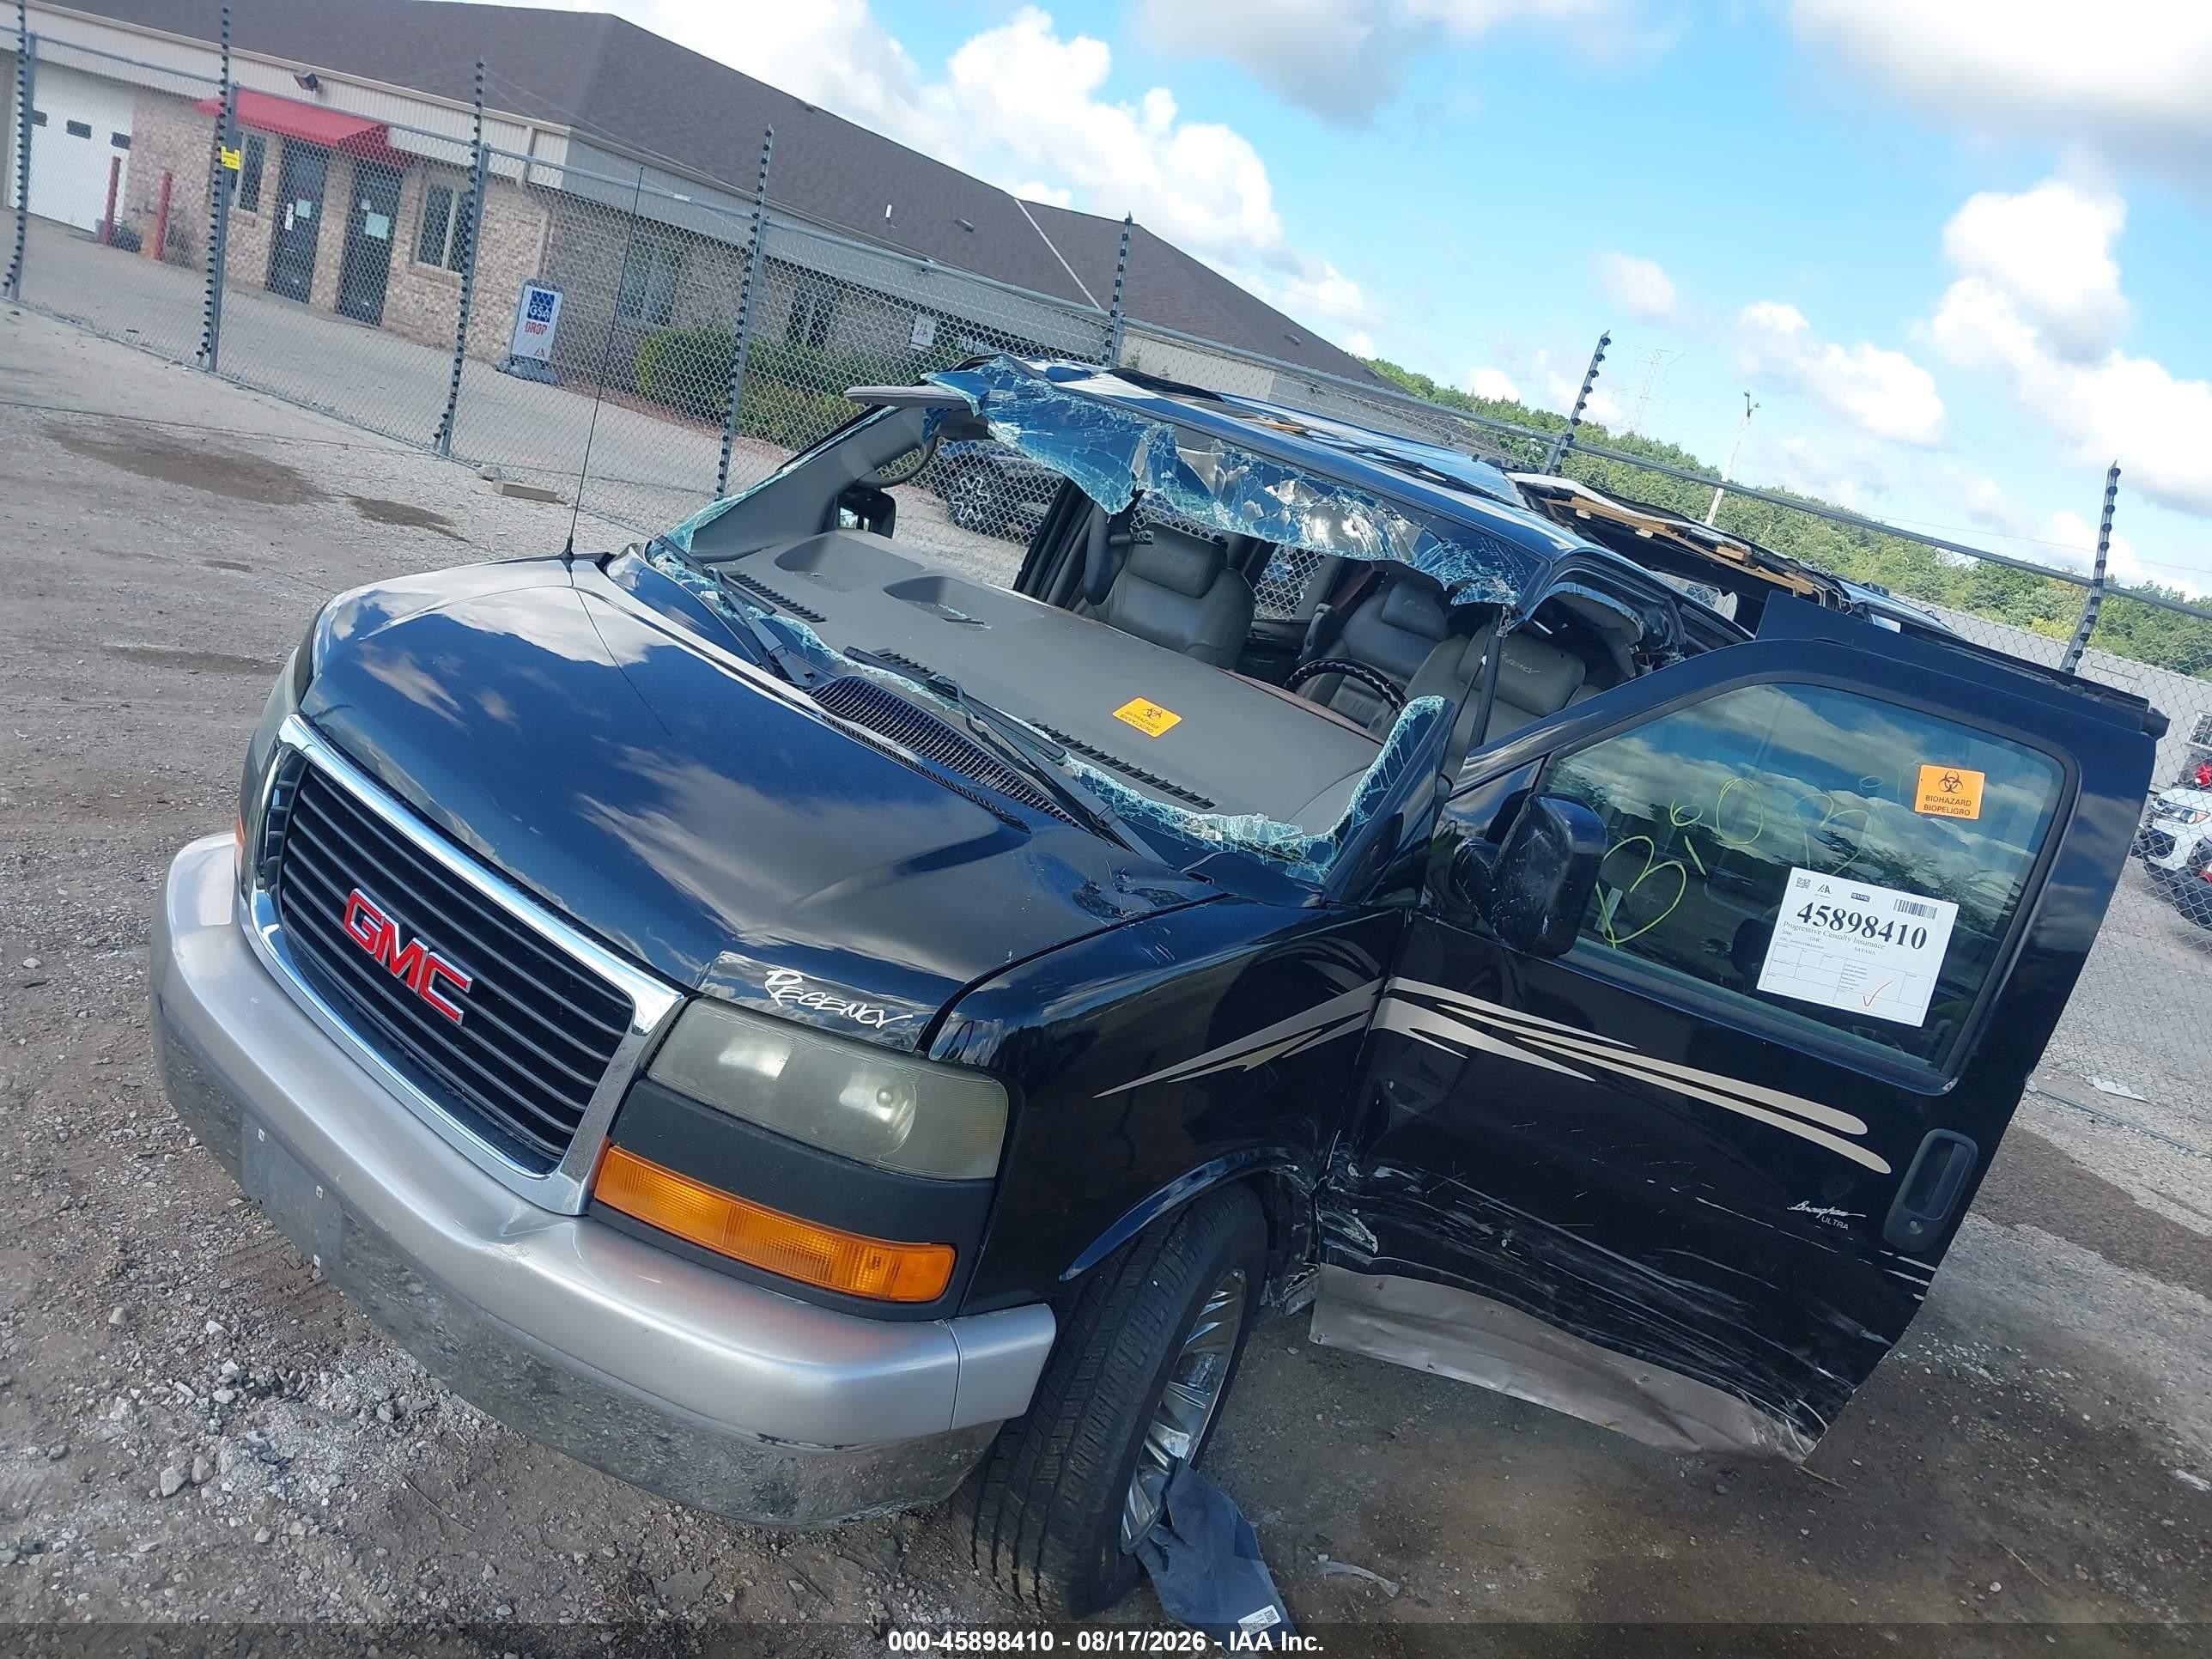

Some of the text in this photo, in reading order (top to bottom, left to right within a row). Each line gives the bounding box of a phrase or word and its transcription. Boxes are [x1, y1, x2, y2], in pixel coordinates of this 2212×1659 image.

[525, 320, 548, 335] DROP
[1925, 794, 1972, 807] BIOHAZARD
[1923, 804, 1971, 816] BIOPELIGRO
[1796, 902, 1928, 950] 45898410
[1783, 921, 1886, 950] Progressive Casualty Insurance
[344, 888, 472, 1026] GMC
[1820, 1215, 1849, 1230] ULTRA
